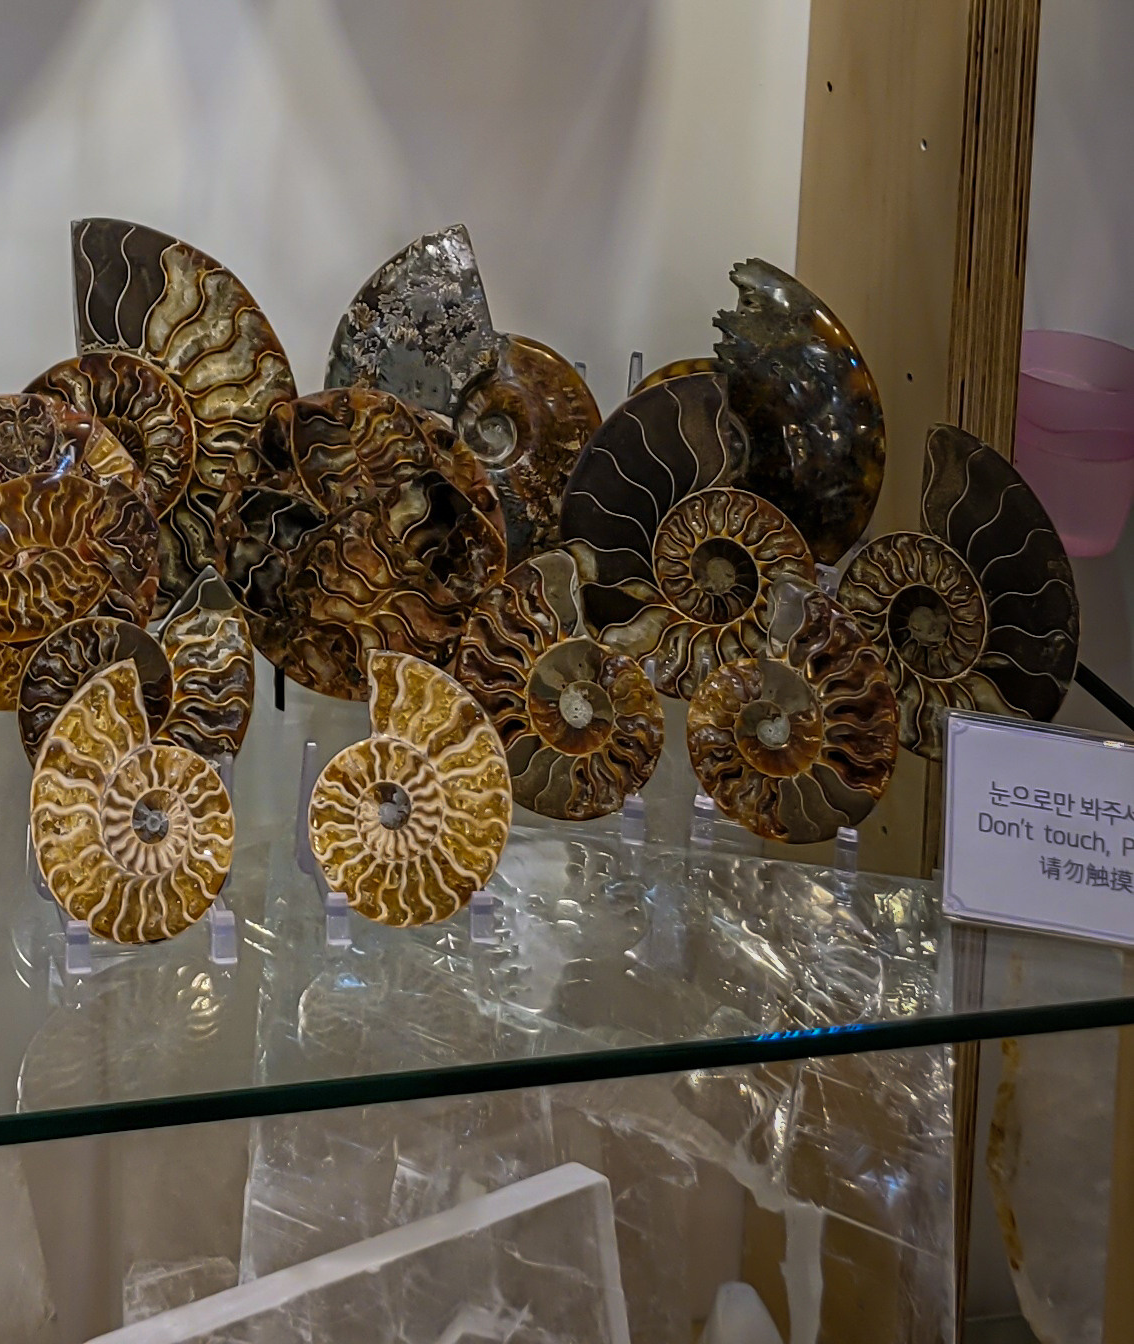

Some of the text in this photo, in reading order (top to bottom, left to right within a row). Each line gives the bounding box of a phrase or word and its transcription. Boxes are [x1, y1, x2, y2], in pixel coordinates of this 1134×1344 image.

[989, 780, 1076, 818] 눈으로만
[978, 812, 1034, 841] Don't
[1044, 824, 1111, 858] touch,
[1039, 854, 1133, 894] 请勿触摸
